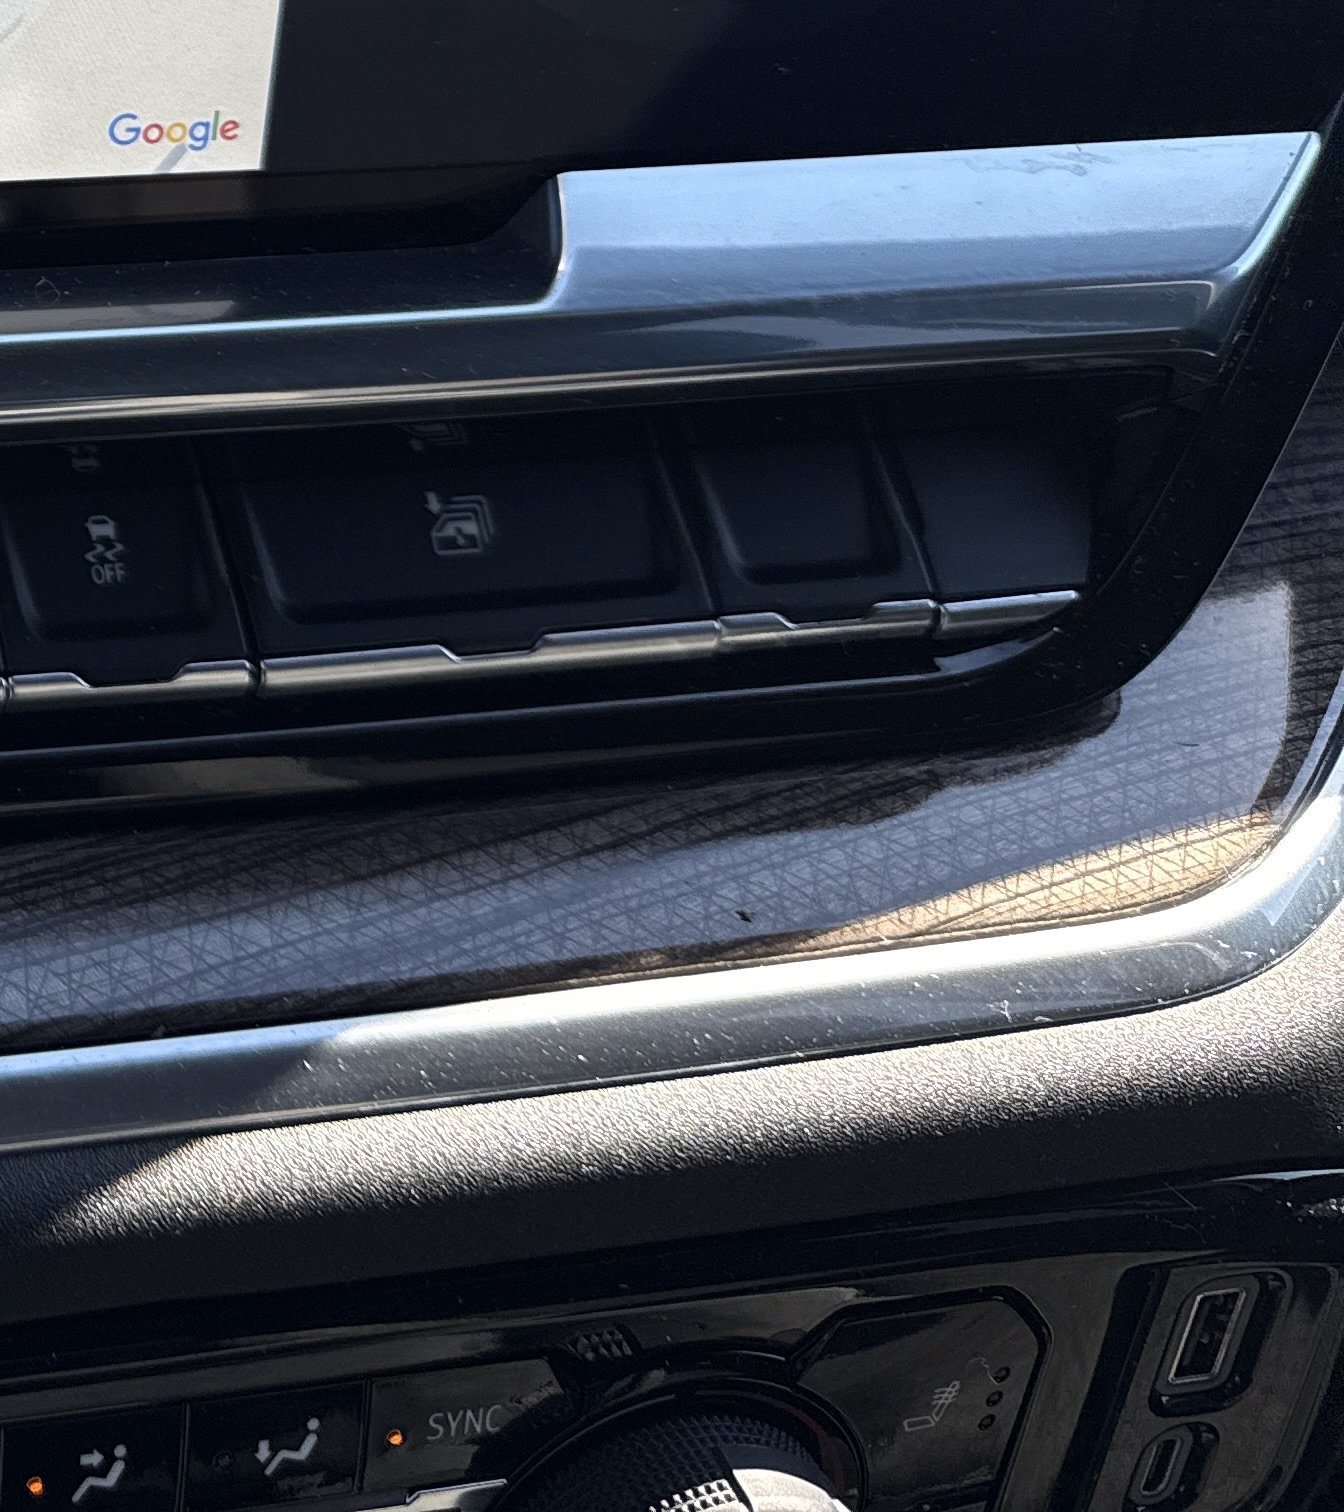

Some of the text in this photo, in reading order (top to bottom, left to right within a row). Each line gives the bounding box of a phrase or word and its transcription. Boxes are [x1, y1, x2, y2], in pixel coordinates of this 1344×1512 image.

[108, 110, 241, 152] Google
[91, 561, 126, 584] OFF
[427, 1404, 502, 1440] SYNC
